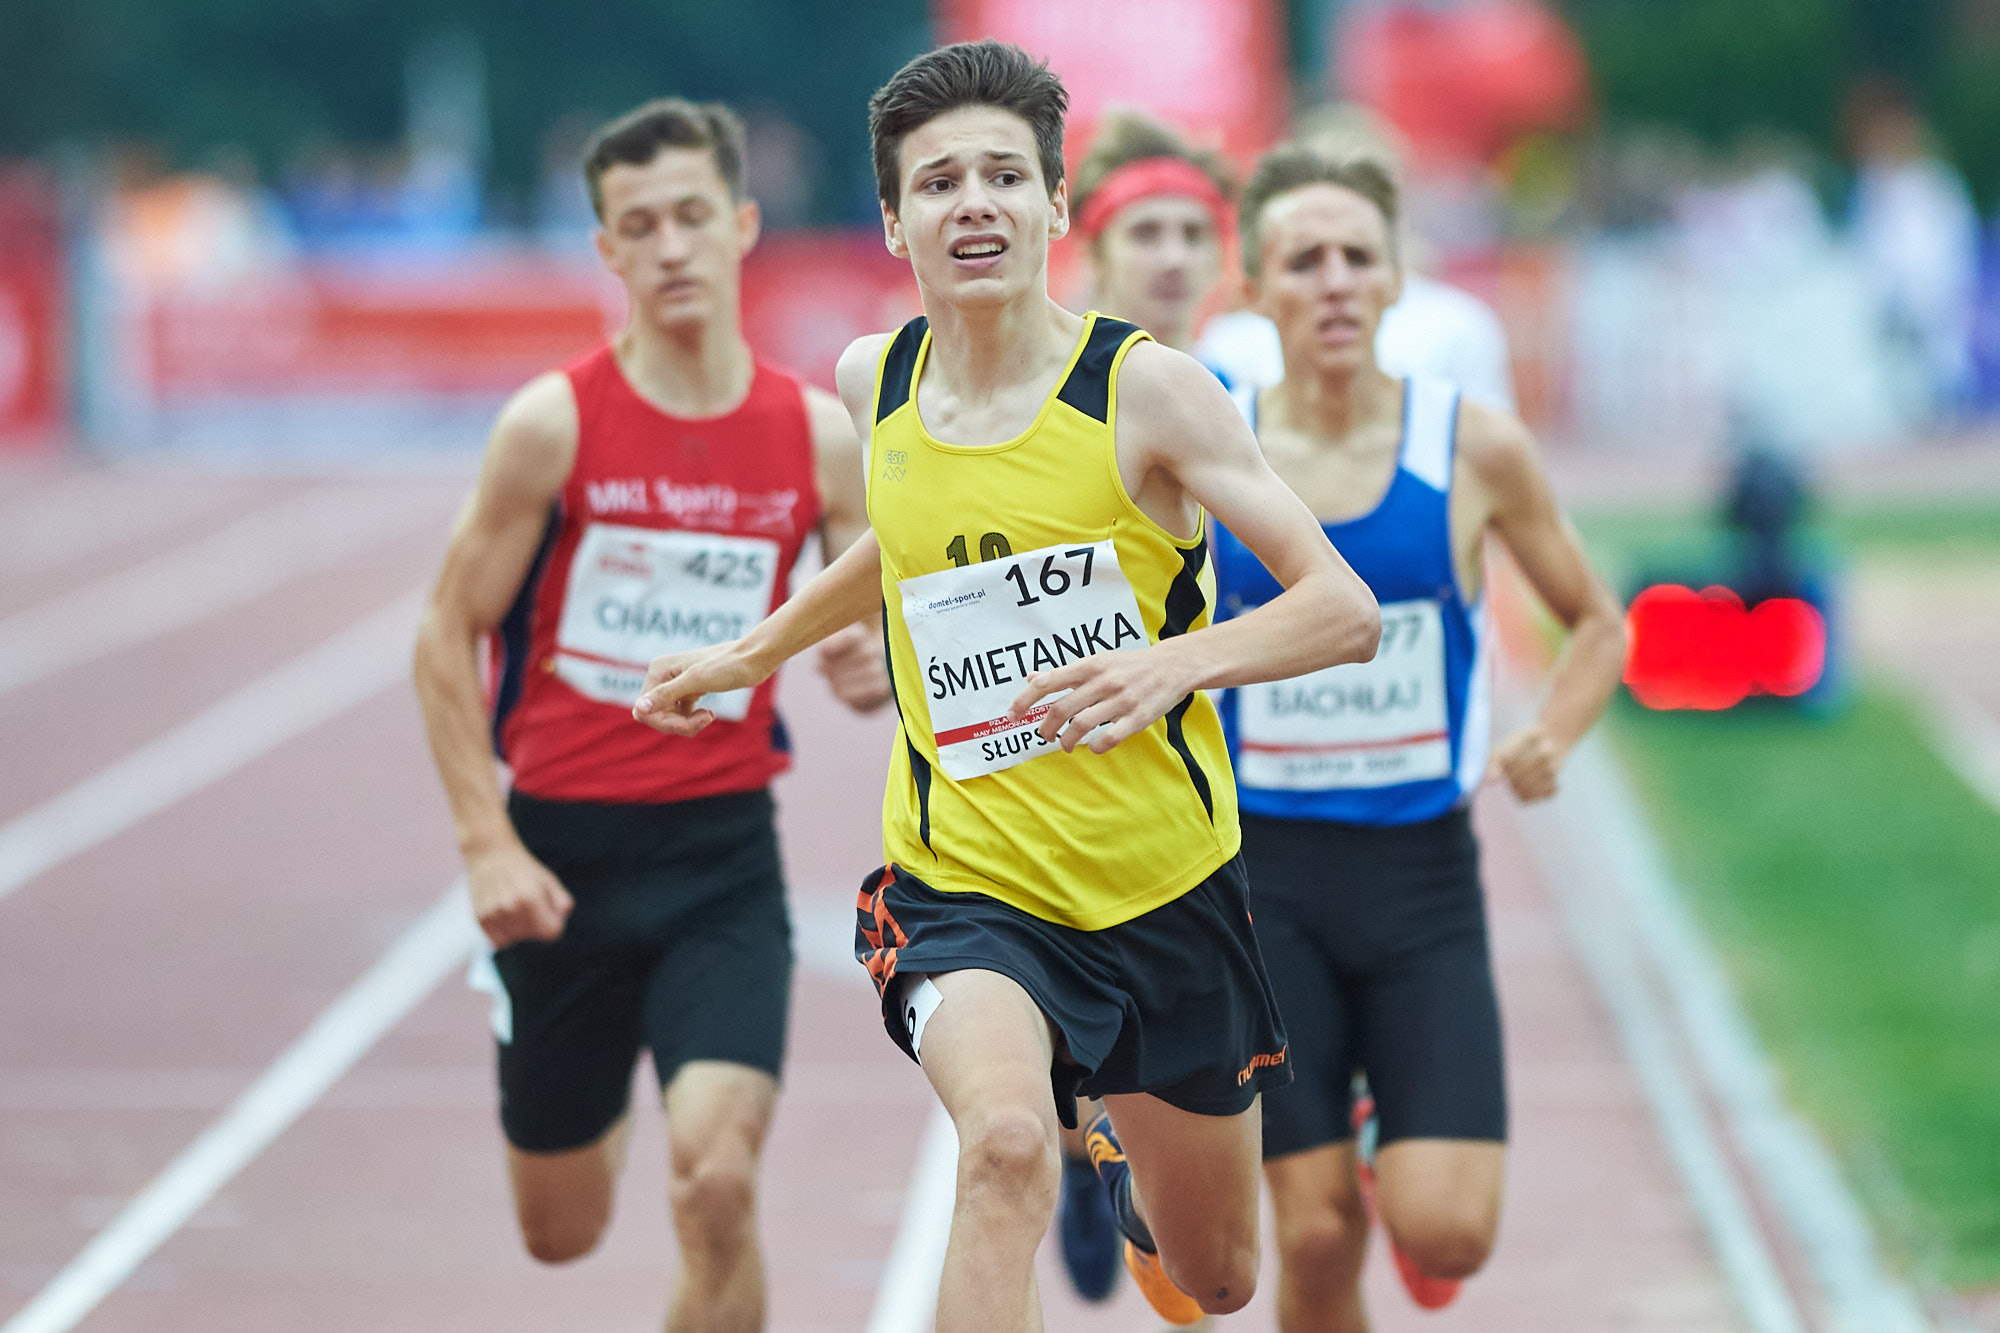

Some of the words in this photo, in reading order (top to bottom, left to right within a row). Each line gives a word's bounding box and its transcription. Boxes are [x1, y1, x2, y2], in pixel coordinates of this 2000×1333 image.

[685, 550, 763, 588] 425
[1005, 547, 1095, 607] 167
[928, 589, 987, 609] domtel-sport.pl
[928, 611, 1141, 701] ŚMIETANKA
[982, 728, 1060, 761] SŁUPS
